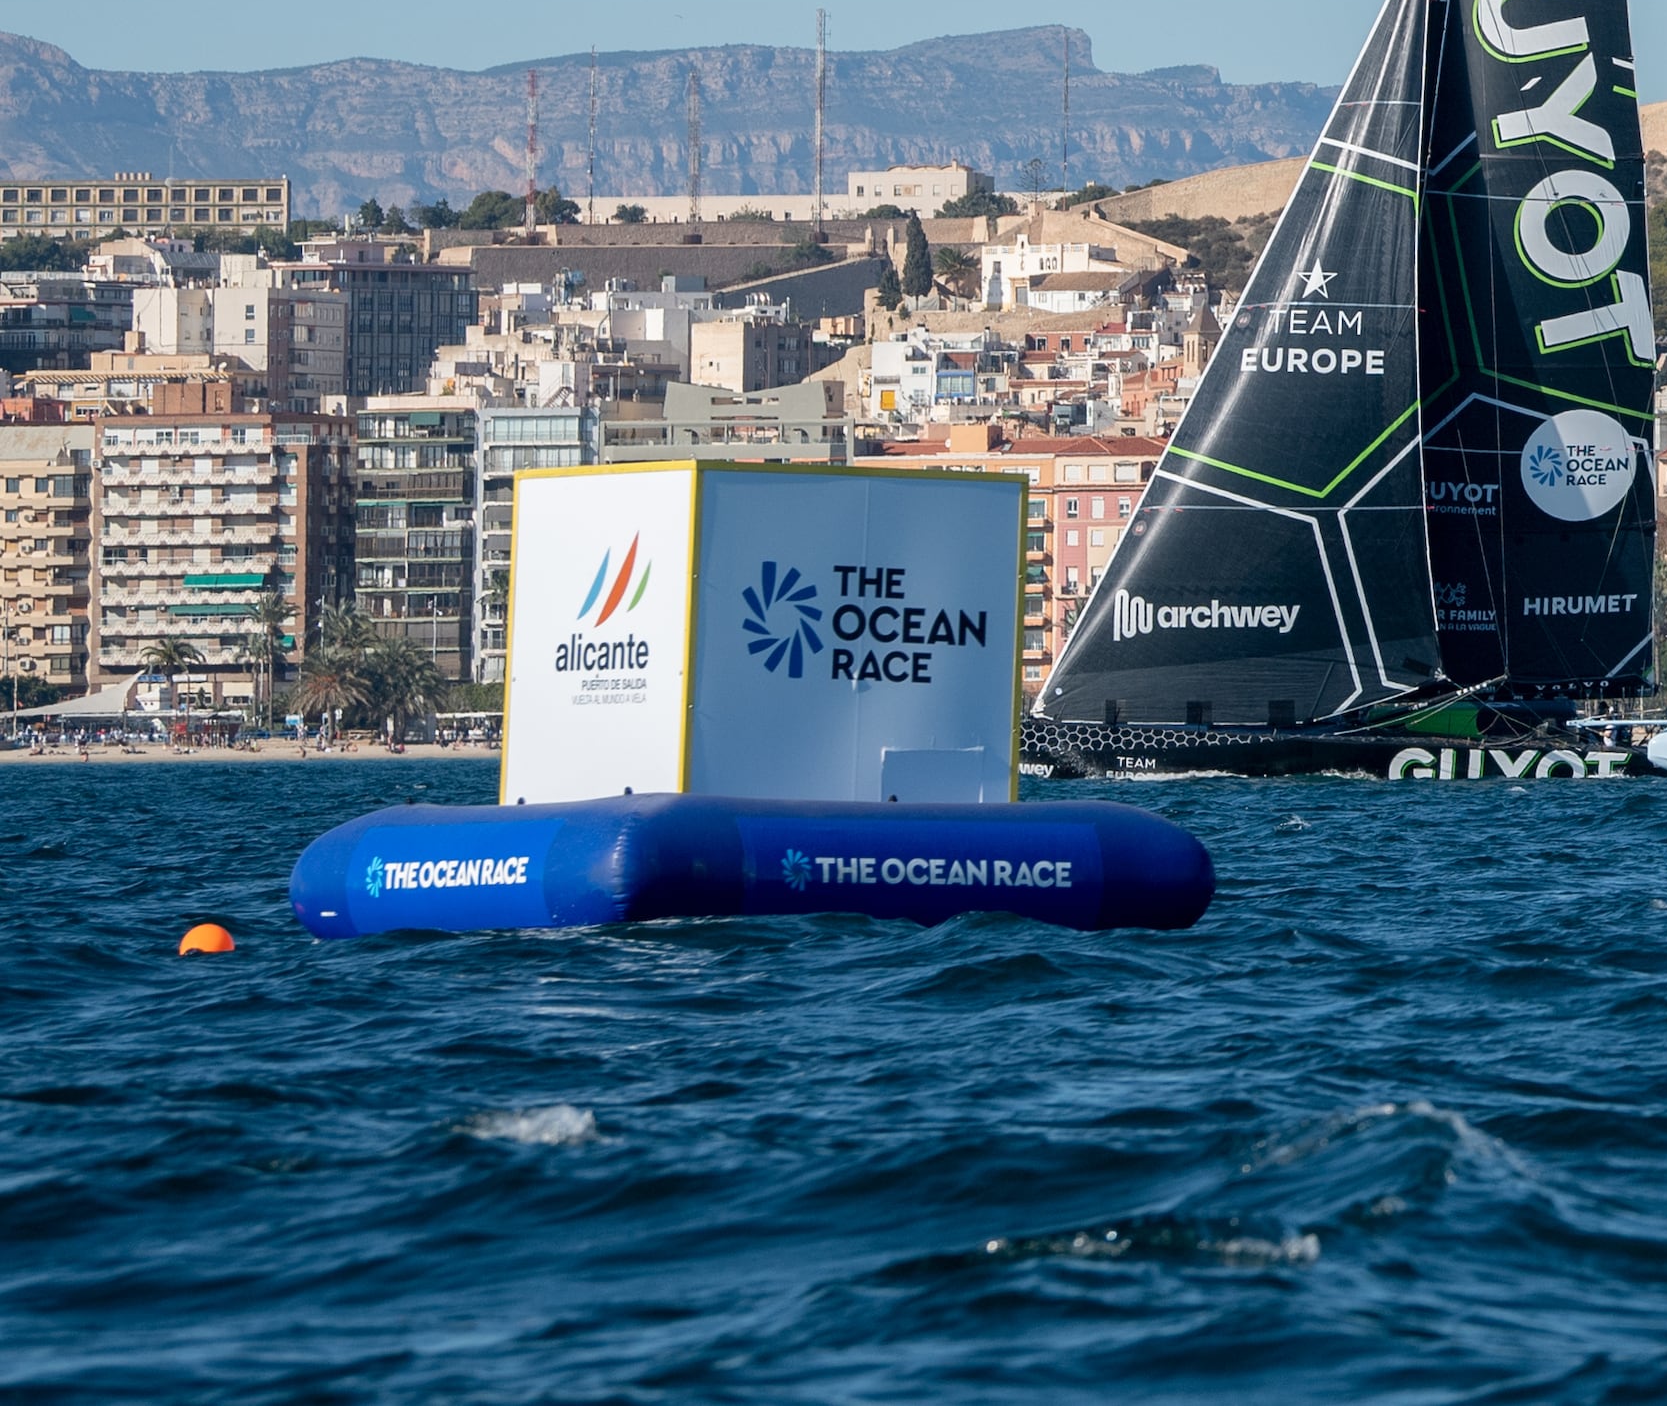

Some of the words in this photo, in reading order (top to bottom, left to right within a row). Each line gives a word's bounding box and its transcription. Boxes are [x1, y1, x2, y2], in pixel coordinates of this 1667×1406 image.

[1268, 309, 1363, 336] TEAM
[1240, 347, 1385, 375] EUROPE
[1566, 444, 1597, 457] THE
[1566, 457, 1629, 473] OCEAN
[1425, 481, 1499, 503] UYOT
[1566, 473, 1607, 487] RACE
[834, 565, 906, 600] THE
[1157, 599, 1301, 634] archwey
[1450, 610, 1496, 621] FAMILY
[1523, 594, 1638, 616] HIRUMET
[831, 604, 988, 648] OCEAN
[555, 633, 649, 672] alicante
[831, 650, 932, 684] RACE
[1535, 680, 1610, 691] VOLVO
[1116, 755, 1157, 769] TEAM
[1388, 747, 1633, 780] GUYOT
[384, 861, 421, 890] THE
[419, 859, 482, 888] OCEAN
[480, 856, 530, 886] RACE
[815, 857, 877, 884] THE
[881, 857, 987, 887] OCEAN
[993, 859, 1072, 888] RACE
